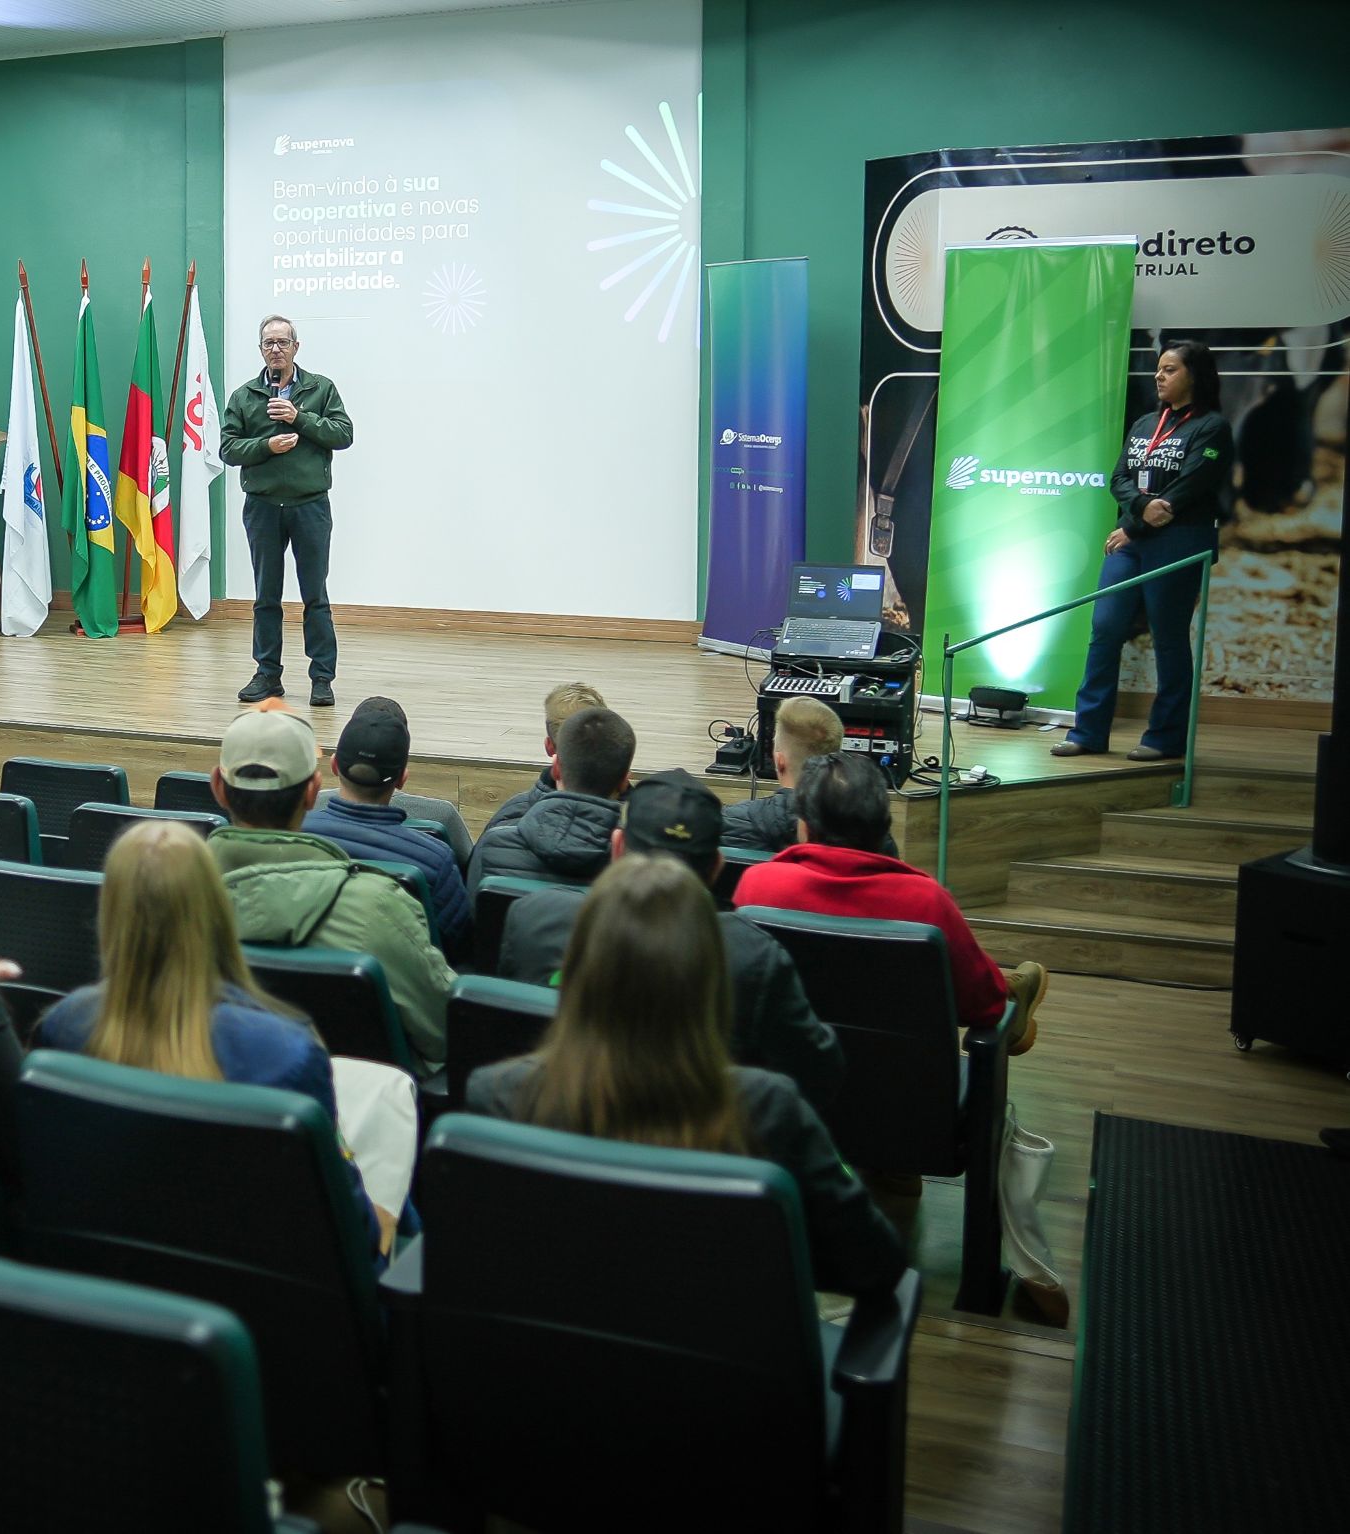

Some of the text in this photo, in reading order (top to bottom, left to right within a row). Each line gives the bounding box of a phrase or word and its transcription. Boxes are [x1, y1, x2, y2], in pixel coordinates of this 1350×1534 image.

[290, 138, 354, 152] supernova
[273, 174, 439, 199] Bem-vindo à sua
[273, 198, 479, 225] Cooperativa e novas
[273, 222, 469, 249] oportunidades para
[1135, 229, 1255, 257] direto
[273, 247, 403, 269] rentabilizar a
[1135, 263, 1198, 276] TRIJAL
[273, 270, 400, 297] propriedade.
[980, 468, 1105, 487] supernova
